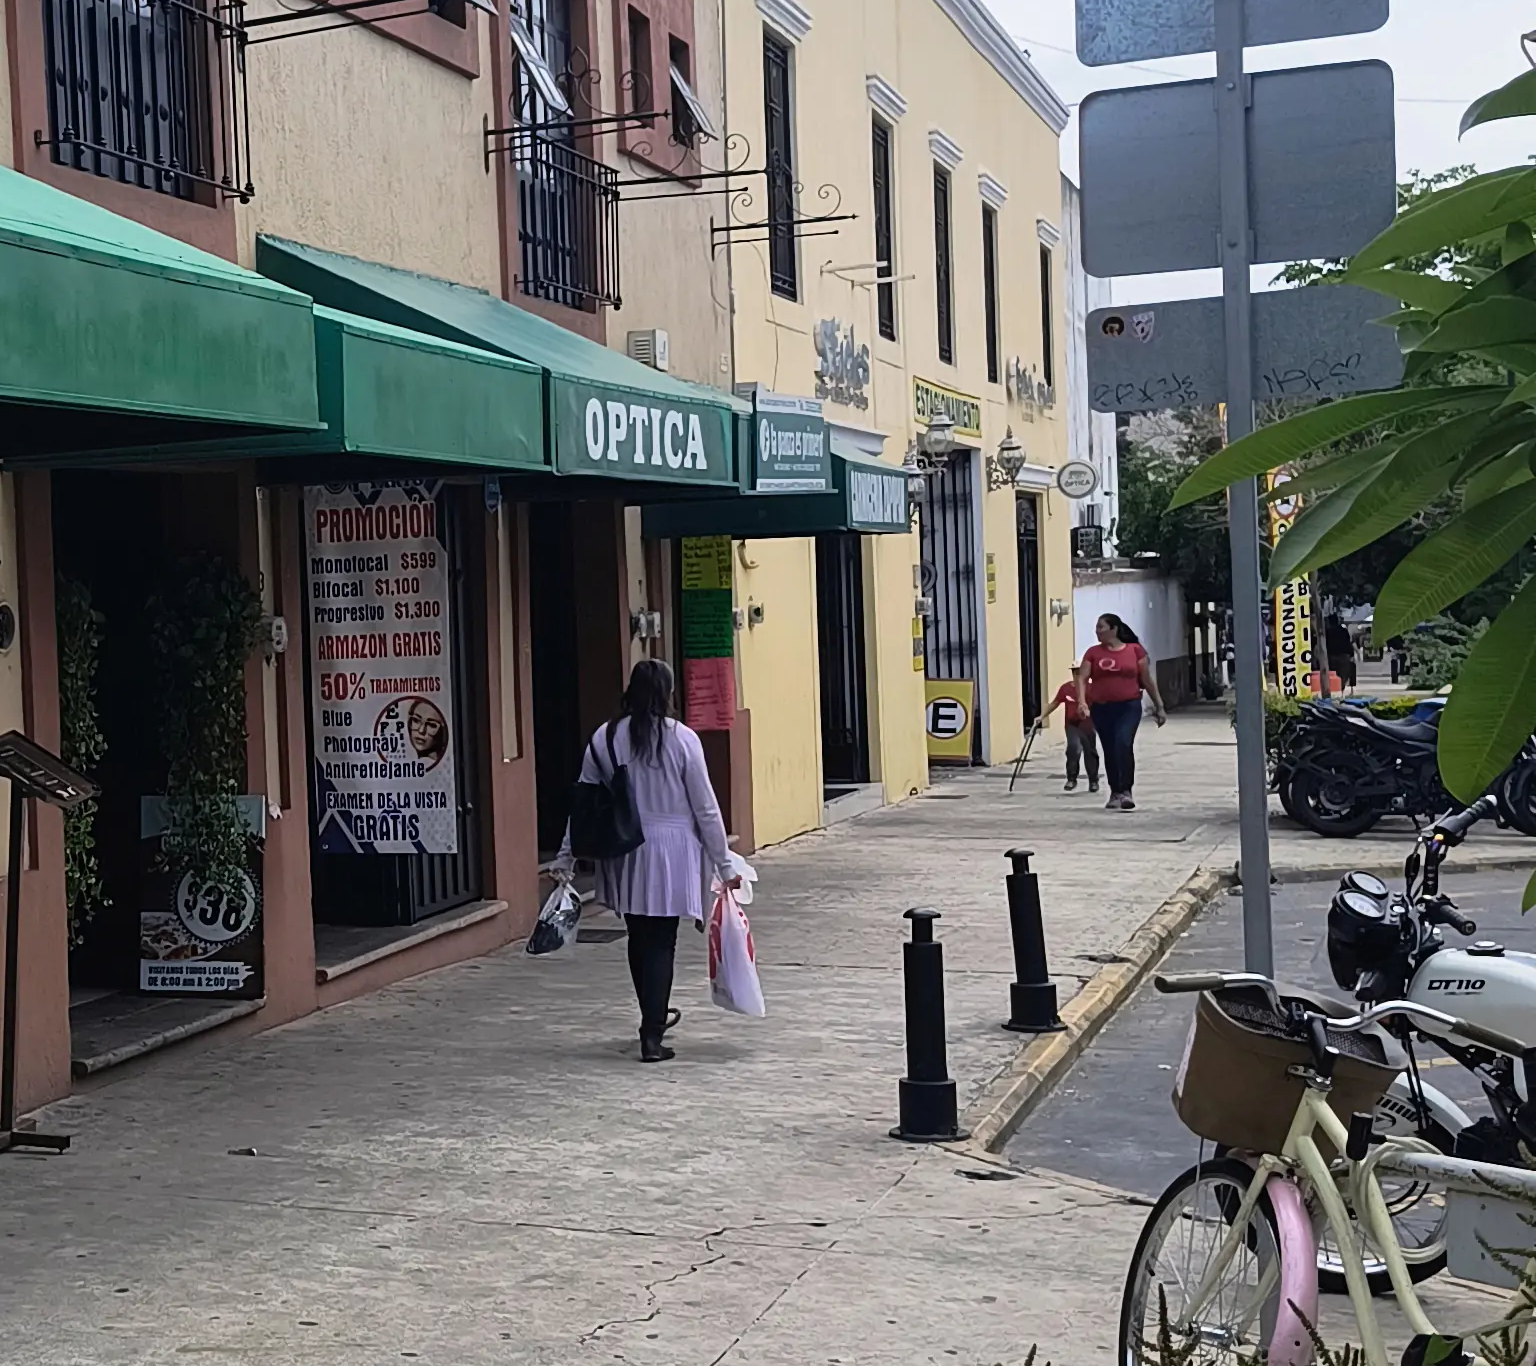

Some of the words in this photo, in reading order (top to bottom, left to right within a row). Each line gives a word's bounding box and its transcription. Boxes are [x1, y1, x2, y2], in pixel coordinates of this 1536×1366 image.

[585, 397, 708, 470] OPTICA
[312, 553, 389, 575] Monofocal
[400, 551, 437, 570] $599
[313, 579, 364, 600] Bifocal
[375, 576, 420, 597] $1,100
[314, 603, 385, 624] Progresivo
[394, 600, 441, 621] $1,300
[318, 633, 388, 661] ARMAZON
[392, 630, 442, 658] GRATIS
[1098, 657, 1121, 672] Q
[320, 671, 366, 701] 50%
[369, 676, 441, 694] TRATAMIENTOS
[322, 709, 353, 727] Blue
[931, 702, 958, 734] E
[324, 735, 399, 754] Photogray
[325, 760, 425, 780] Antireflejante
[327, 791, 373, 810] EXAMEN
[377, 792, 393, 809] DE
[397, 792, 411, 809] LA
[415, 791, 447, 809] VISTA
[352, 814, 421, 842] GRATIS
[148, 976, 159, 987] DE
[205, 976, 225, 987] 2:00
[1427, 979, 1486, 991] DT110
